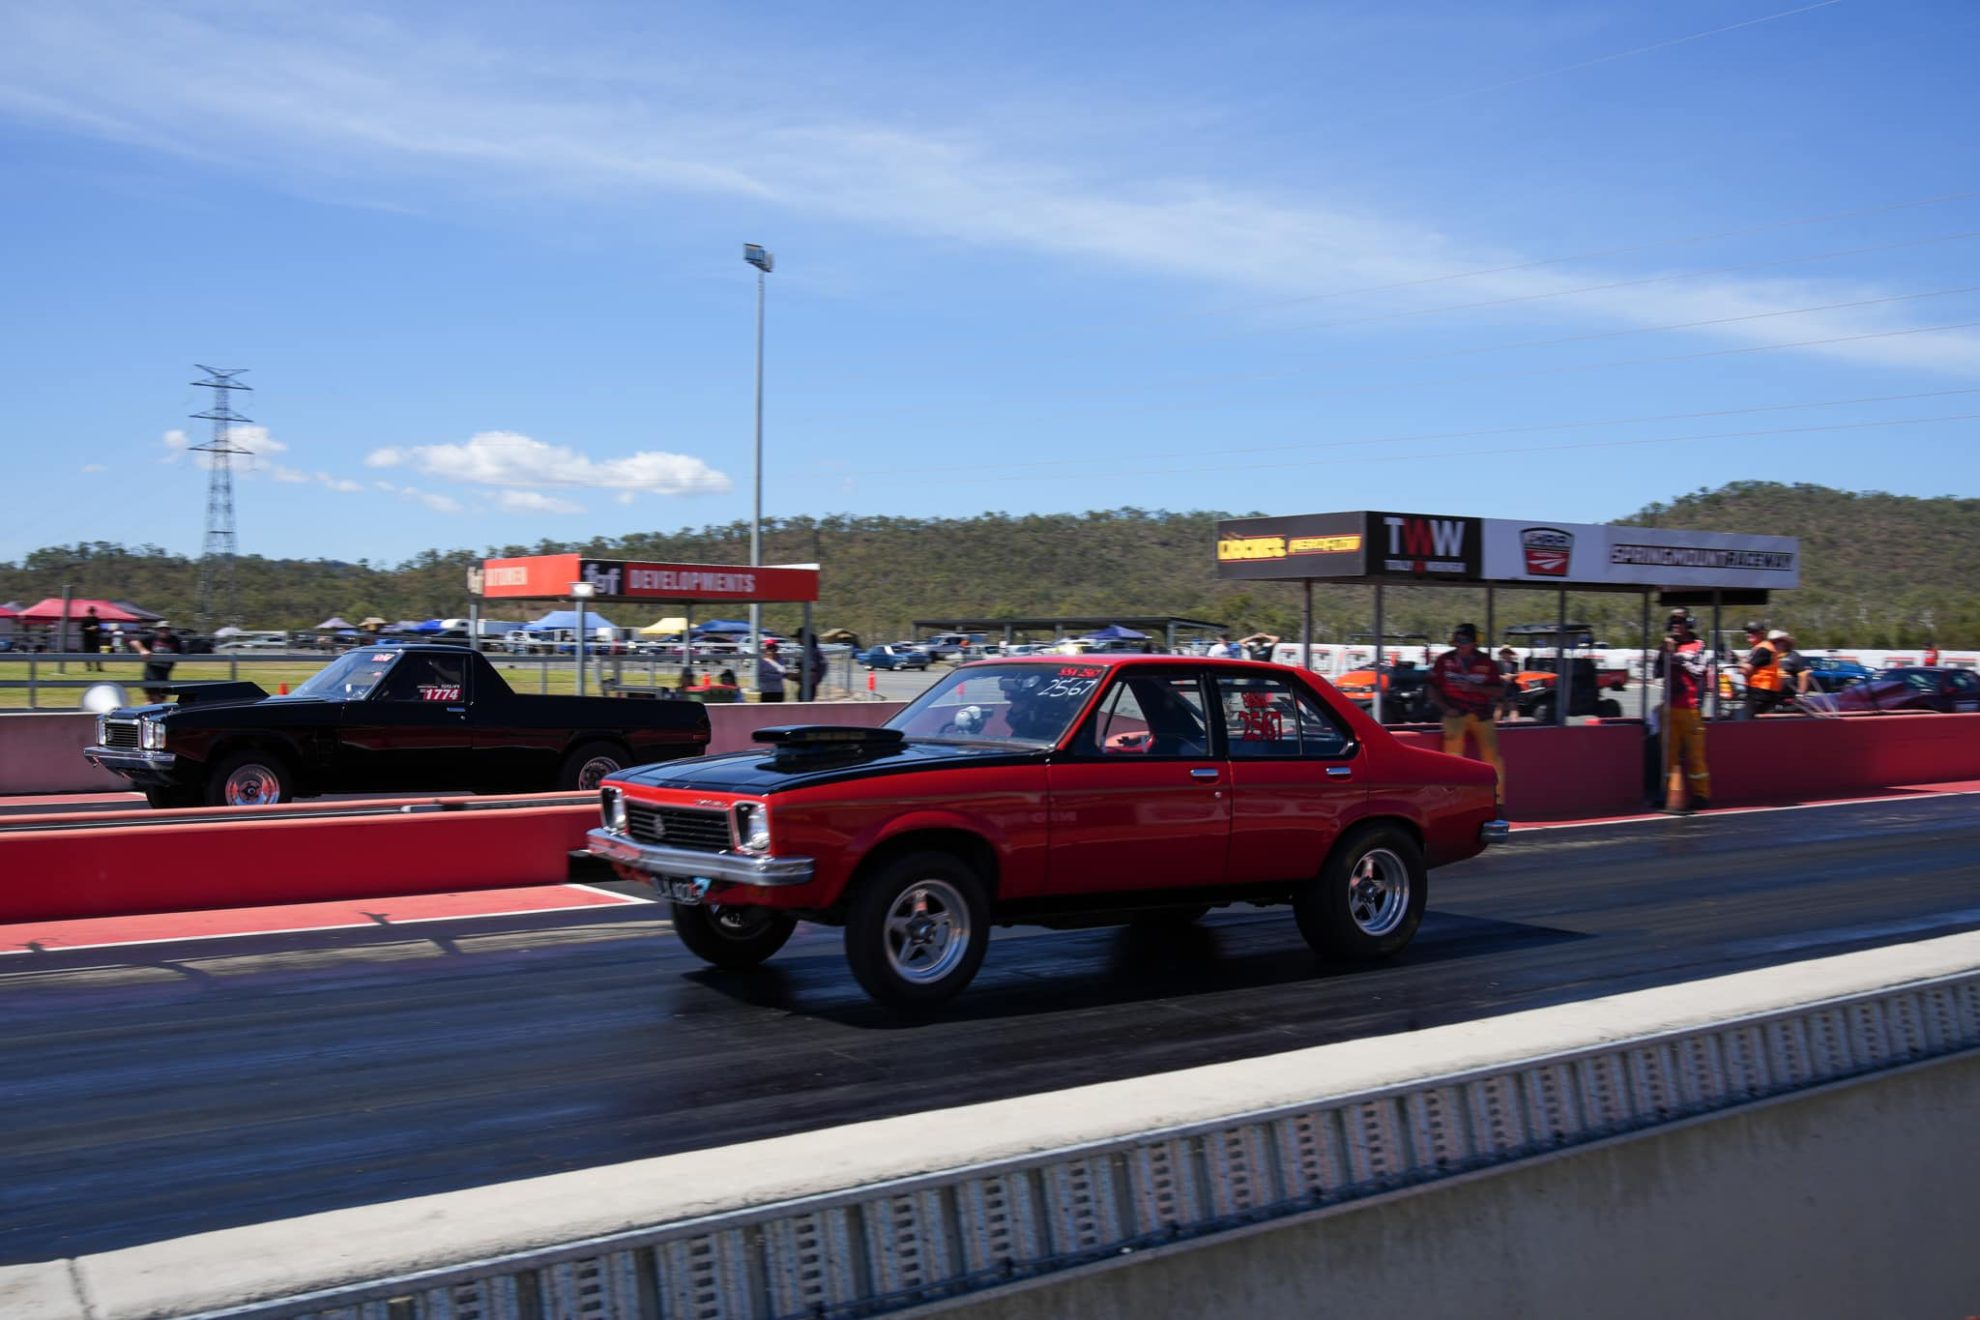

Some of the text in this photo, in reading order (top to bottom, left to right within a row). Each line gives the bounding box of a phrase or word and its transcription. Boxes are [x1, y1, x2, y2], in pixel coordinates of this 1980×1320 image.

[1383, 516, 1466, 557] TWW
[629, 569, 756, 593] DEVELOPMENTS
[426, 688, 460, 701] 1774
[1037, 677, 1099, 698] 2567
